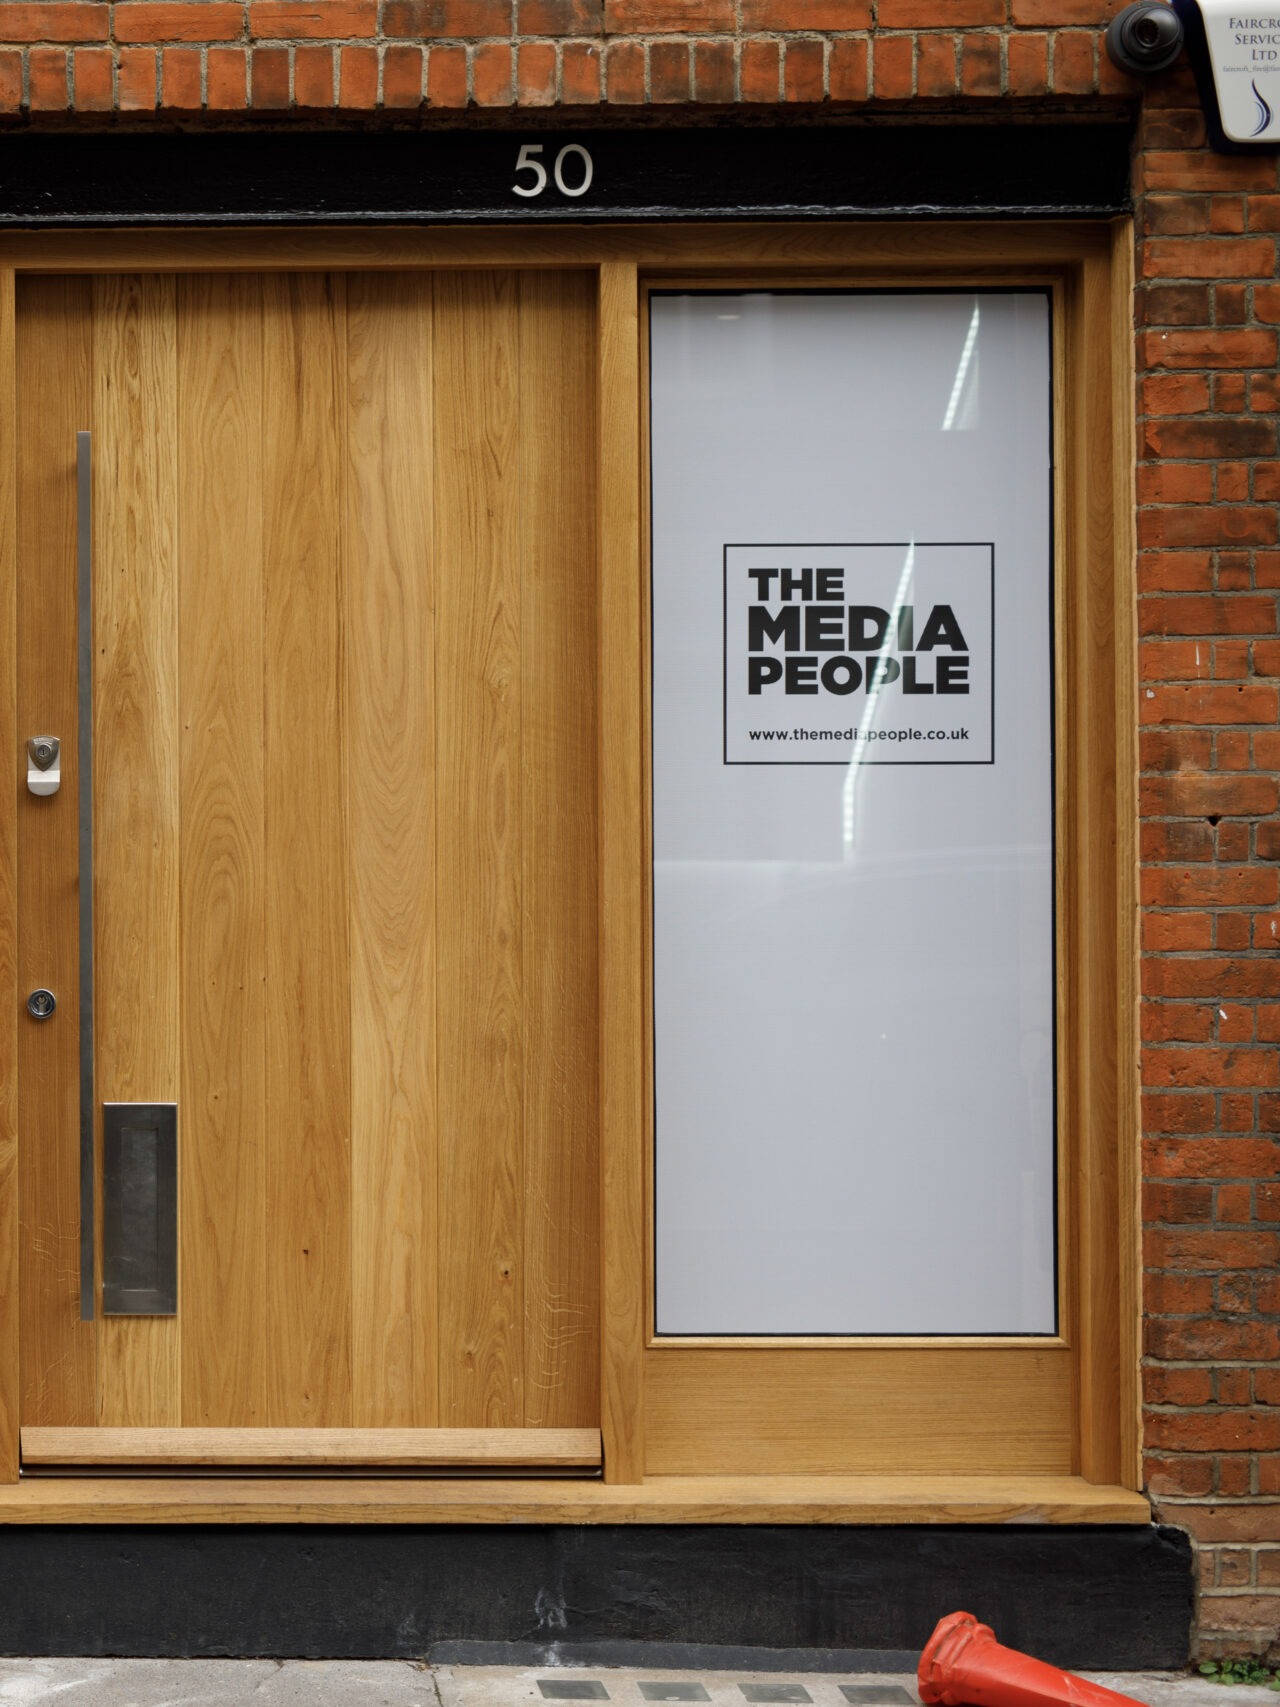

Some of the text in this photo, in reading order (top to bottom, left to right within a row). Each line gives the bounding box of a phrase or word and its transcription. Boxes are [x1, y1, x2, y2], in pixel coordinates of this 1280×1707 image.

[512, 144, 593, 198] 50
[748, 568, 845, 601] THE
[748, 604, 970, 651] MEDIA
[748, 655, 970, 696] PEOPLE
